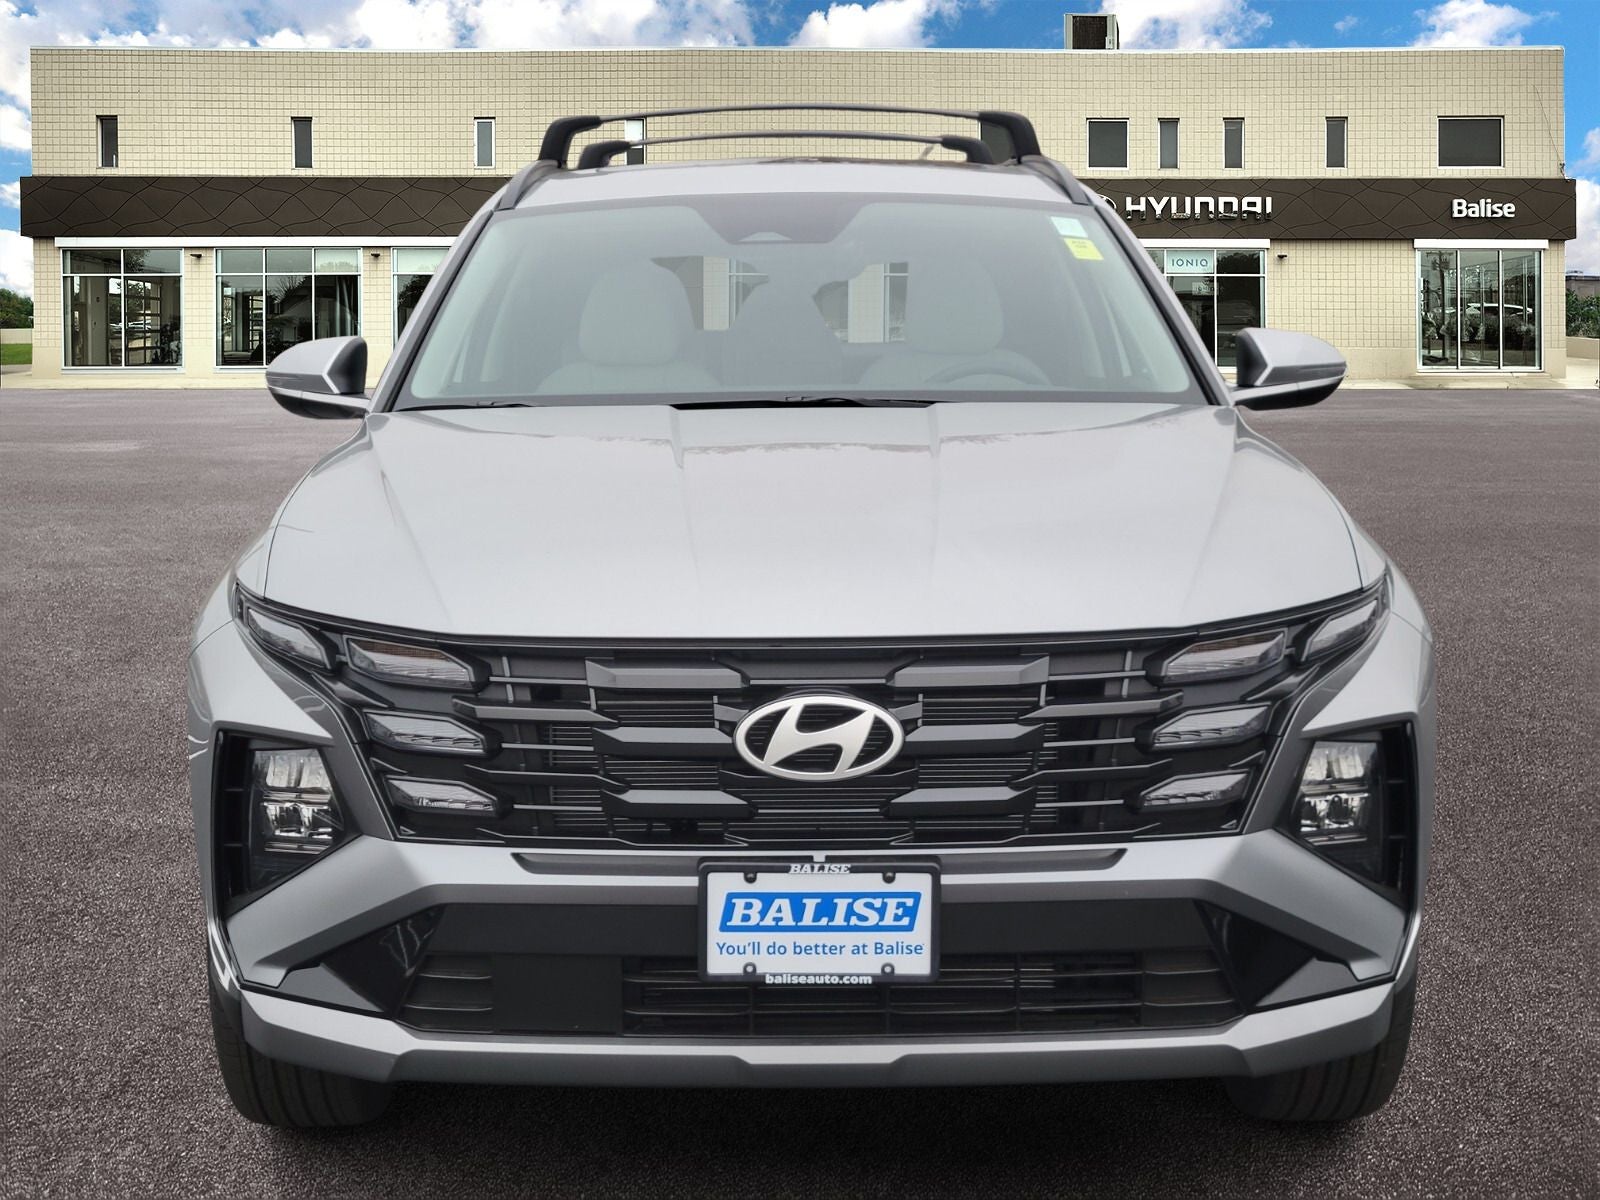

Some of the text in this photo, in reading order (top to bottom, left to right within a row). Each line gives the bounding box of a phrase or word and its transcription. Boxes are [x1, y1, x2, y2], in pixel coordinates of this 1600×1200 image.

[1125, 196, 1272, 220] HYUNDAI
[1452, 198, 1516, 218] Balise
[1171, 258, 1209, 267] IONIQ
[788, 863, 851, 874] BALISE
[726, 898, 914, 926] BALISE
[716, 942, 923, 955] You'll do better at Balise
[765, 973, 872, 985] baliseauto.com
